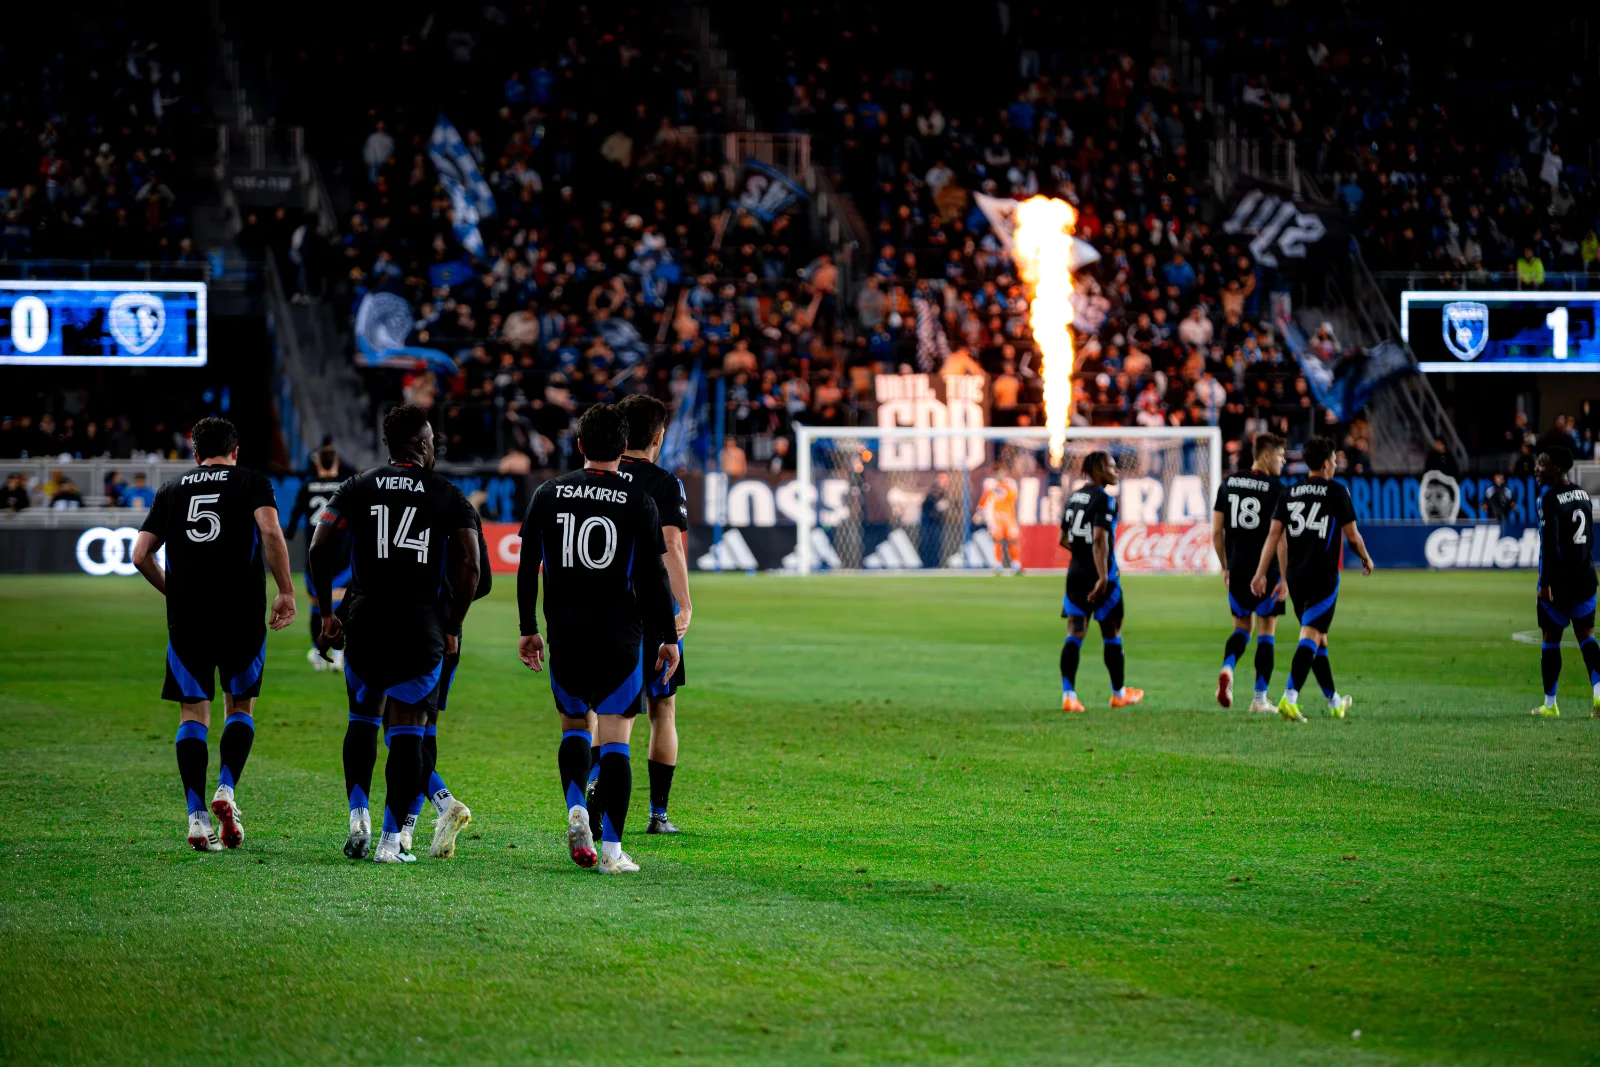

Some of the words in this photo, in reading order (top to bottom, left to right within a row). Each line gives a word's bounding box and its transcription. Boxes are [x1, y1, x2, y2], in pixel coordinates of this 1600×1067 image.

[12, 296, 48, 353] 0
[1547, 307, 1568, 359] 1
[181, 470, 229, 485] MUNIE
[376, 476, 425, 492] VIEIRA
[555, 485, 628, 504] TSAKIRIS
[1227, 476, 1270, 492] ROBERTS
[1290, 485, 1328, 497] LEROUX
[186, 493, 221, 542] 5
[1227, 493, 1261, 530] 18
[1287, 501, 1329, 539] 34
[1572, 508, 1587, 544] 2
[371, 505, 430, 564] 14
[557, 512, 618, 569] 10
